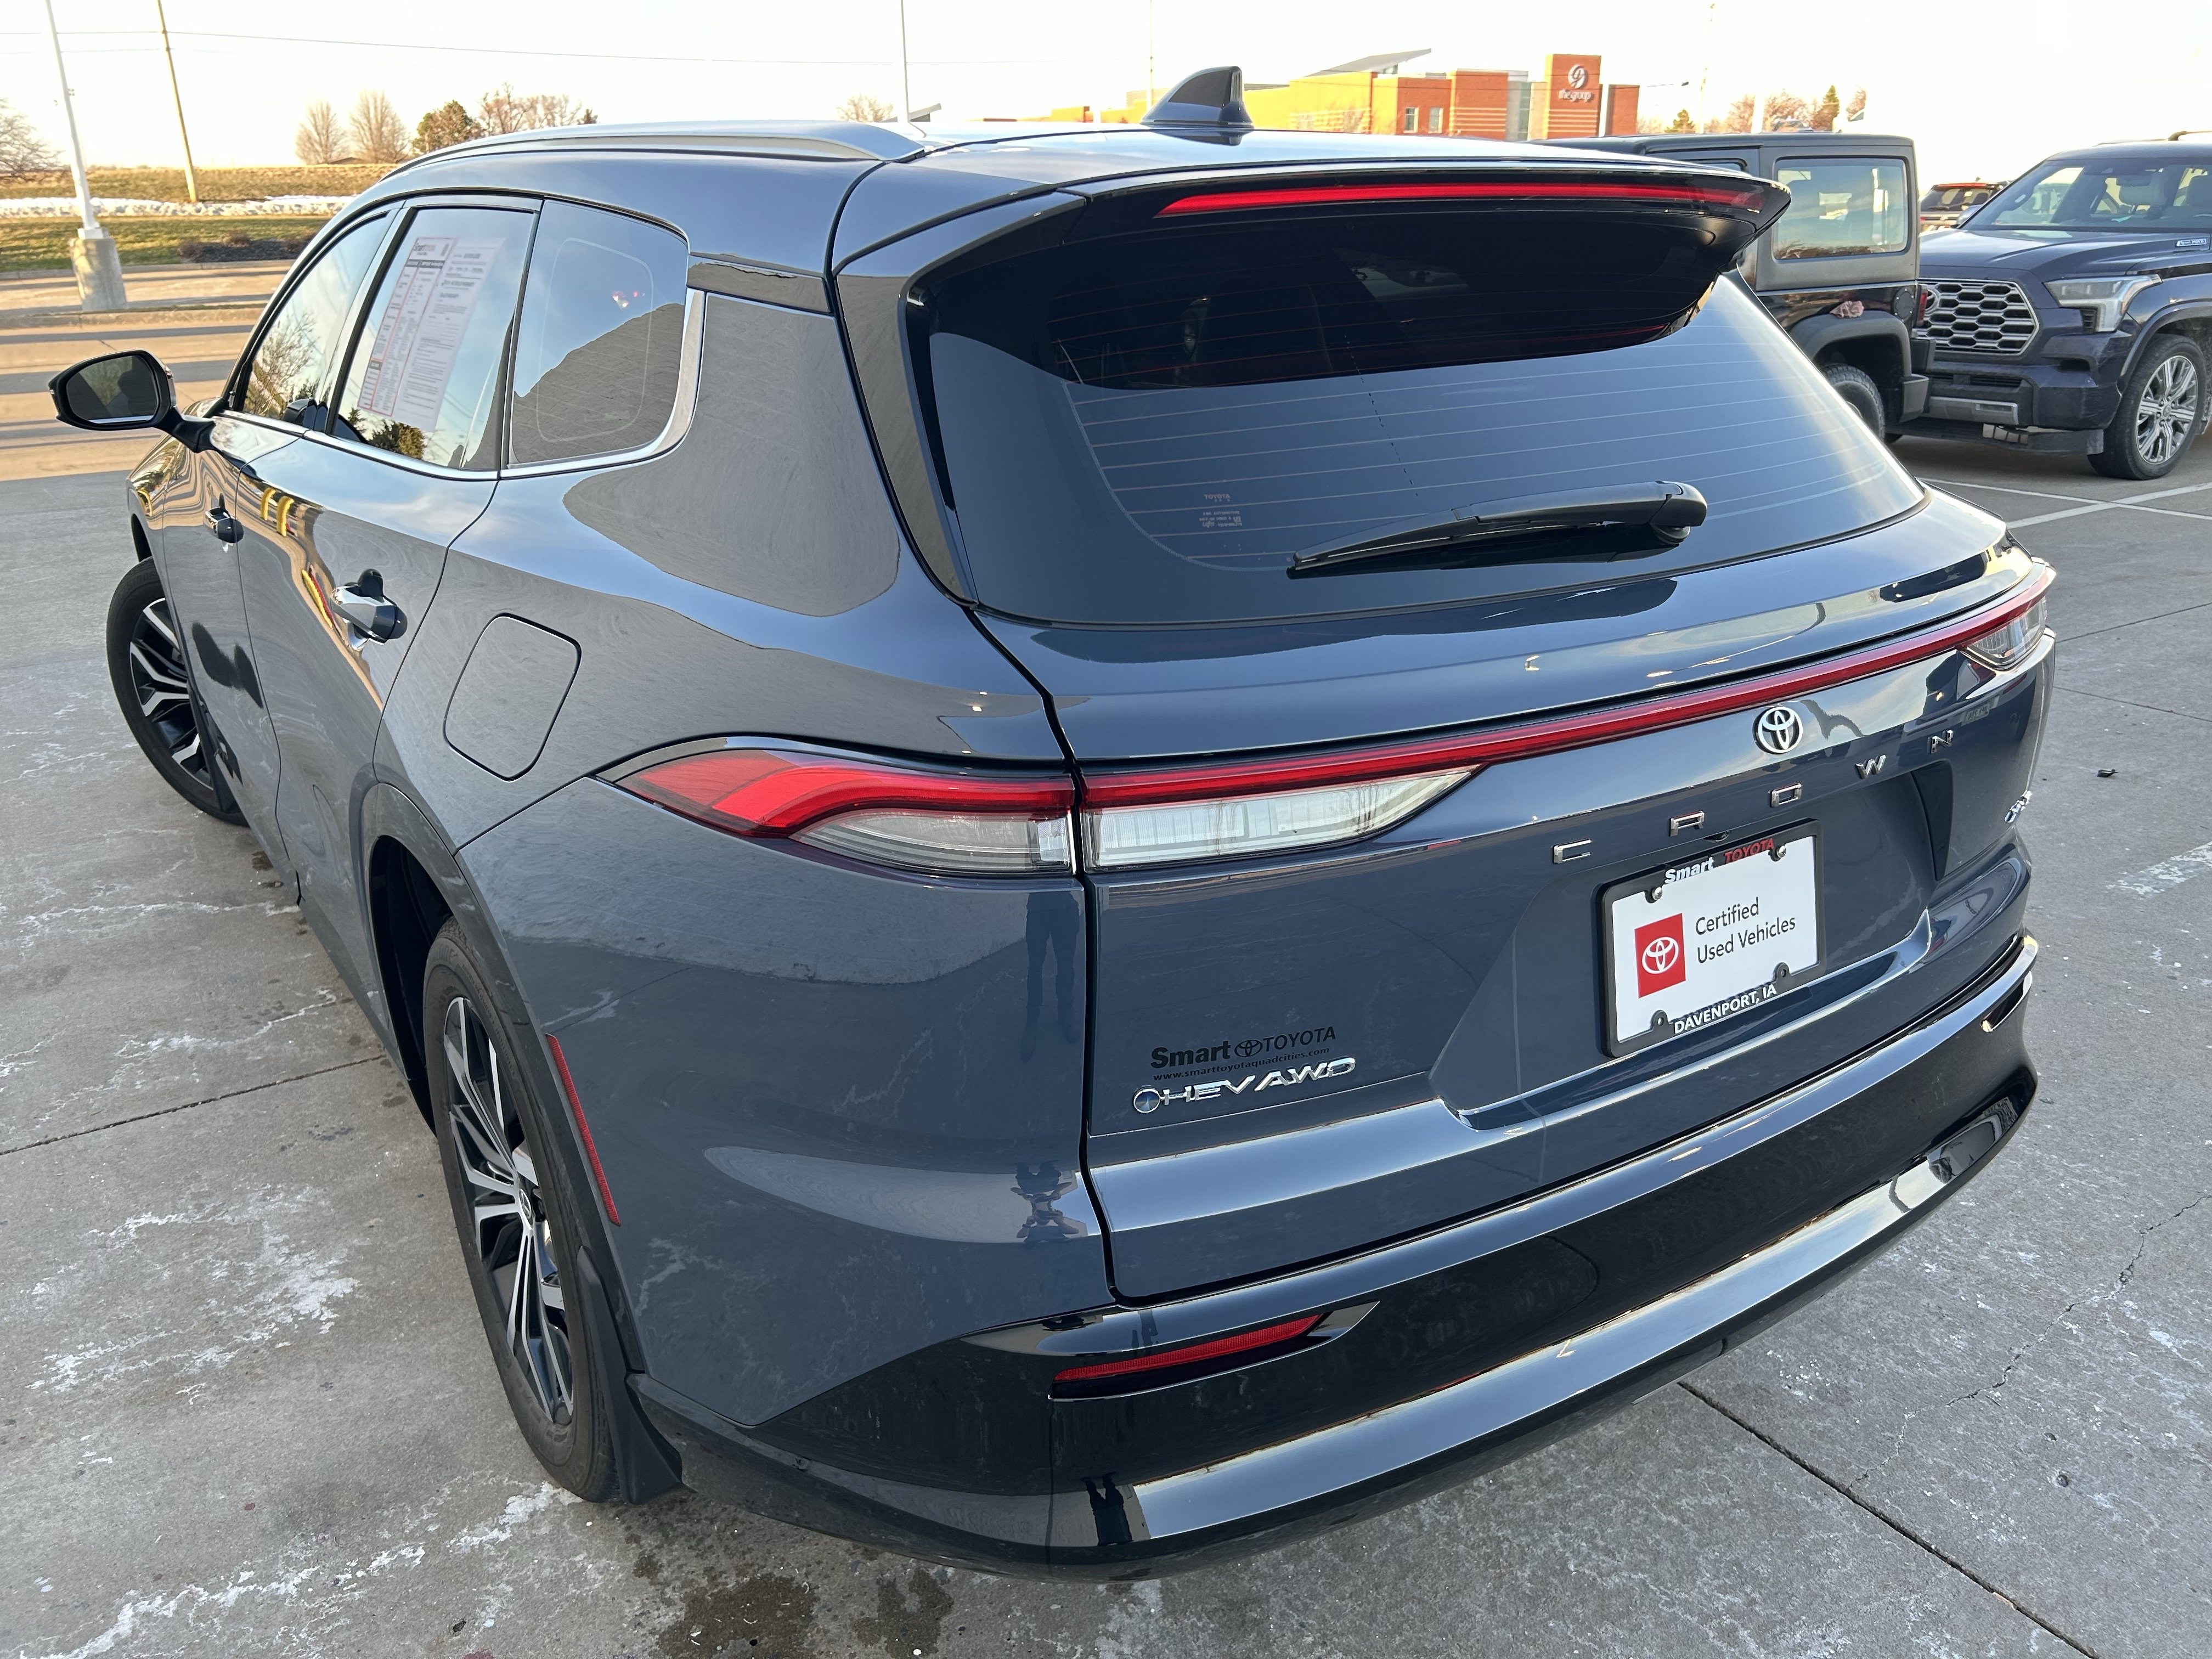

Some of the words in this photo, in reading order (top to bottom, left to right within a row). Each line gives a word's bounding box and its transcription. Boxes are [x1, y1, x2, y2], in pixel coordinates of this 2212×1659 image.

[1664, 856, 1714, 884] Smart
[1724, 837, 1775, 864] TOYOTA
[1695, 896, 1759, 935] Certified
[1697, 934, 1734, 964] Used
[1737, 917, 1796, 949] Vehicles
[1674, 990, 1759, 1035] DAVENPORT,
[1762, 984, 1777, 998] IA
[1150, 1041, 1231, 1069] Smart
[1263, 1026, 1336, 1052] TOYOTA
[1154, 1047, 1330, 1081] www.smarttoyotaquadcities.com
